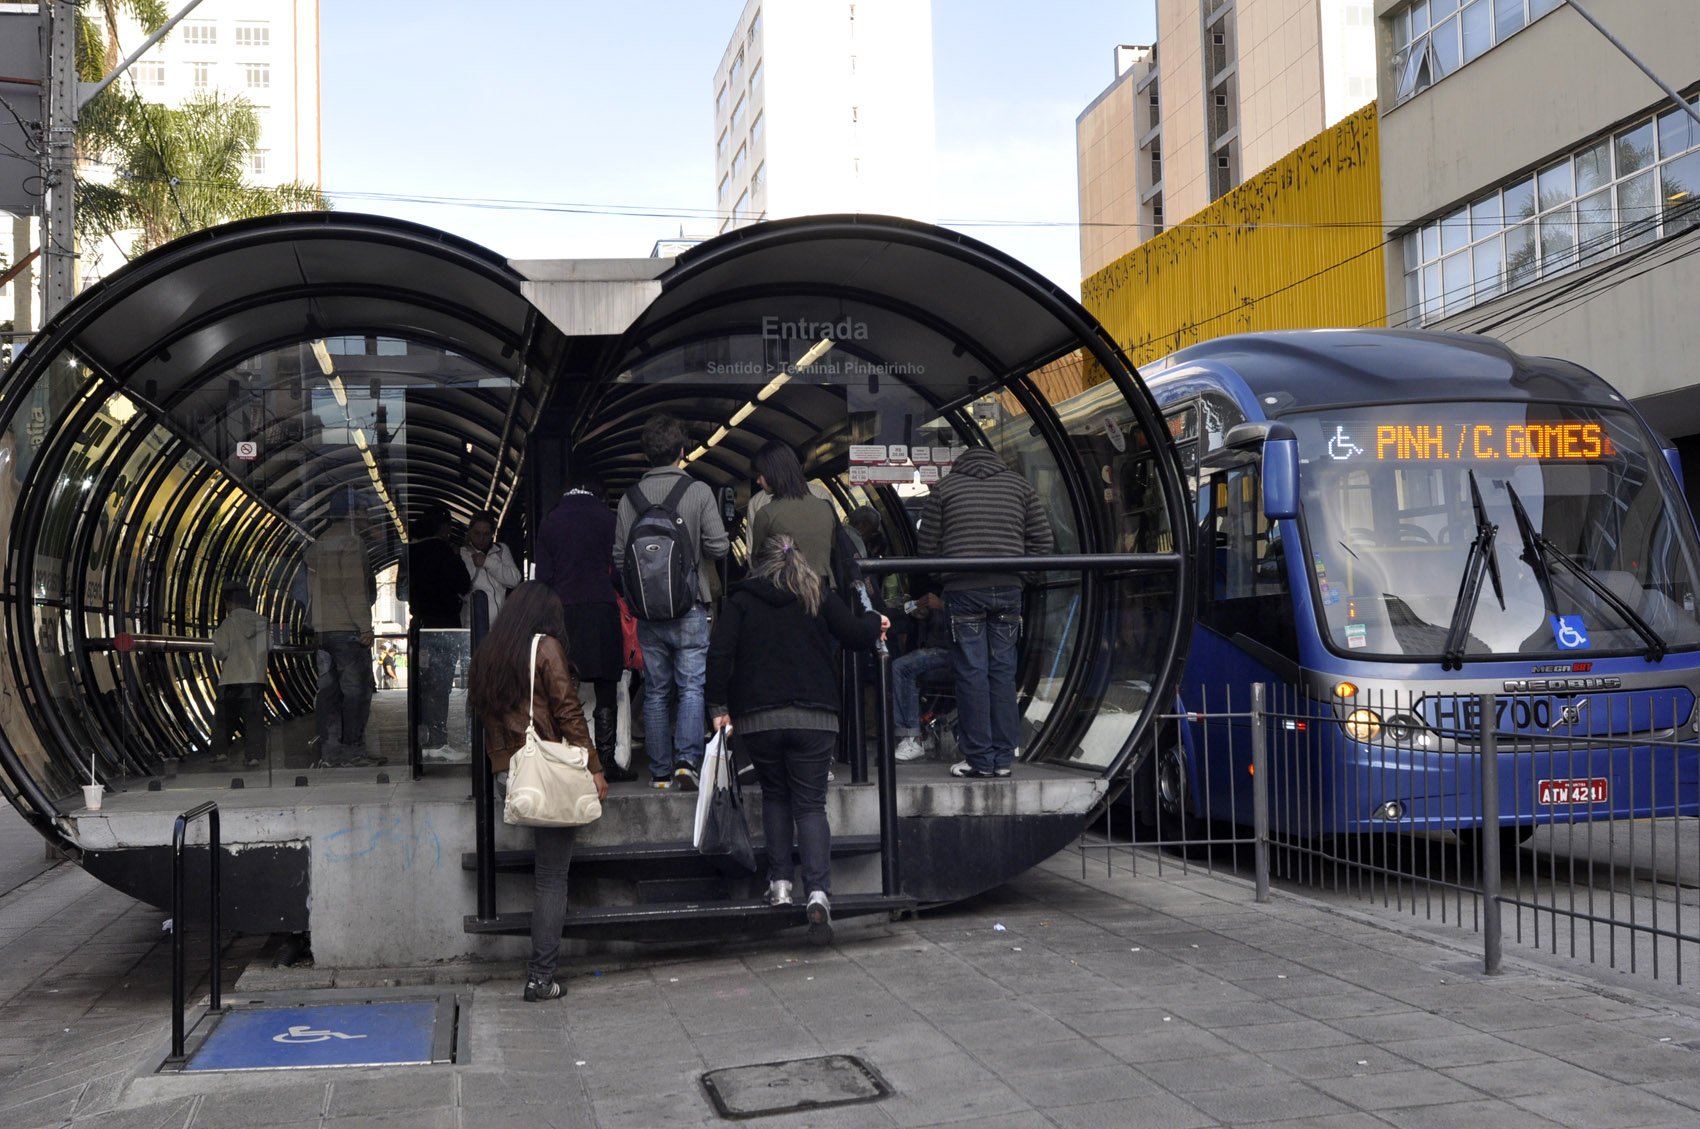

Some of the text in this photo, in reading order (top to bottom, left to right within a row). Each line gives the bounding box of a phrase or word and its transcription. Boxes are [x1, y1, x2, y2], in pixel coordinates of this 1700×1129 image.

[762, 316, 868, 340] Entrada
[707, 361, 762, 374] Sentido
[779, 361, 840, 374] Terminal
[844, 361, 925, 374] Pinheirinho
[1376, 425, 1450, 459] PINH.
[1506, 424, 1601, 458] GOMES
[1531, 665, 1572, 674] MEGA
[1504, 677, 1621, 693] NEOBUS
